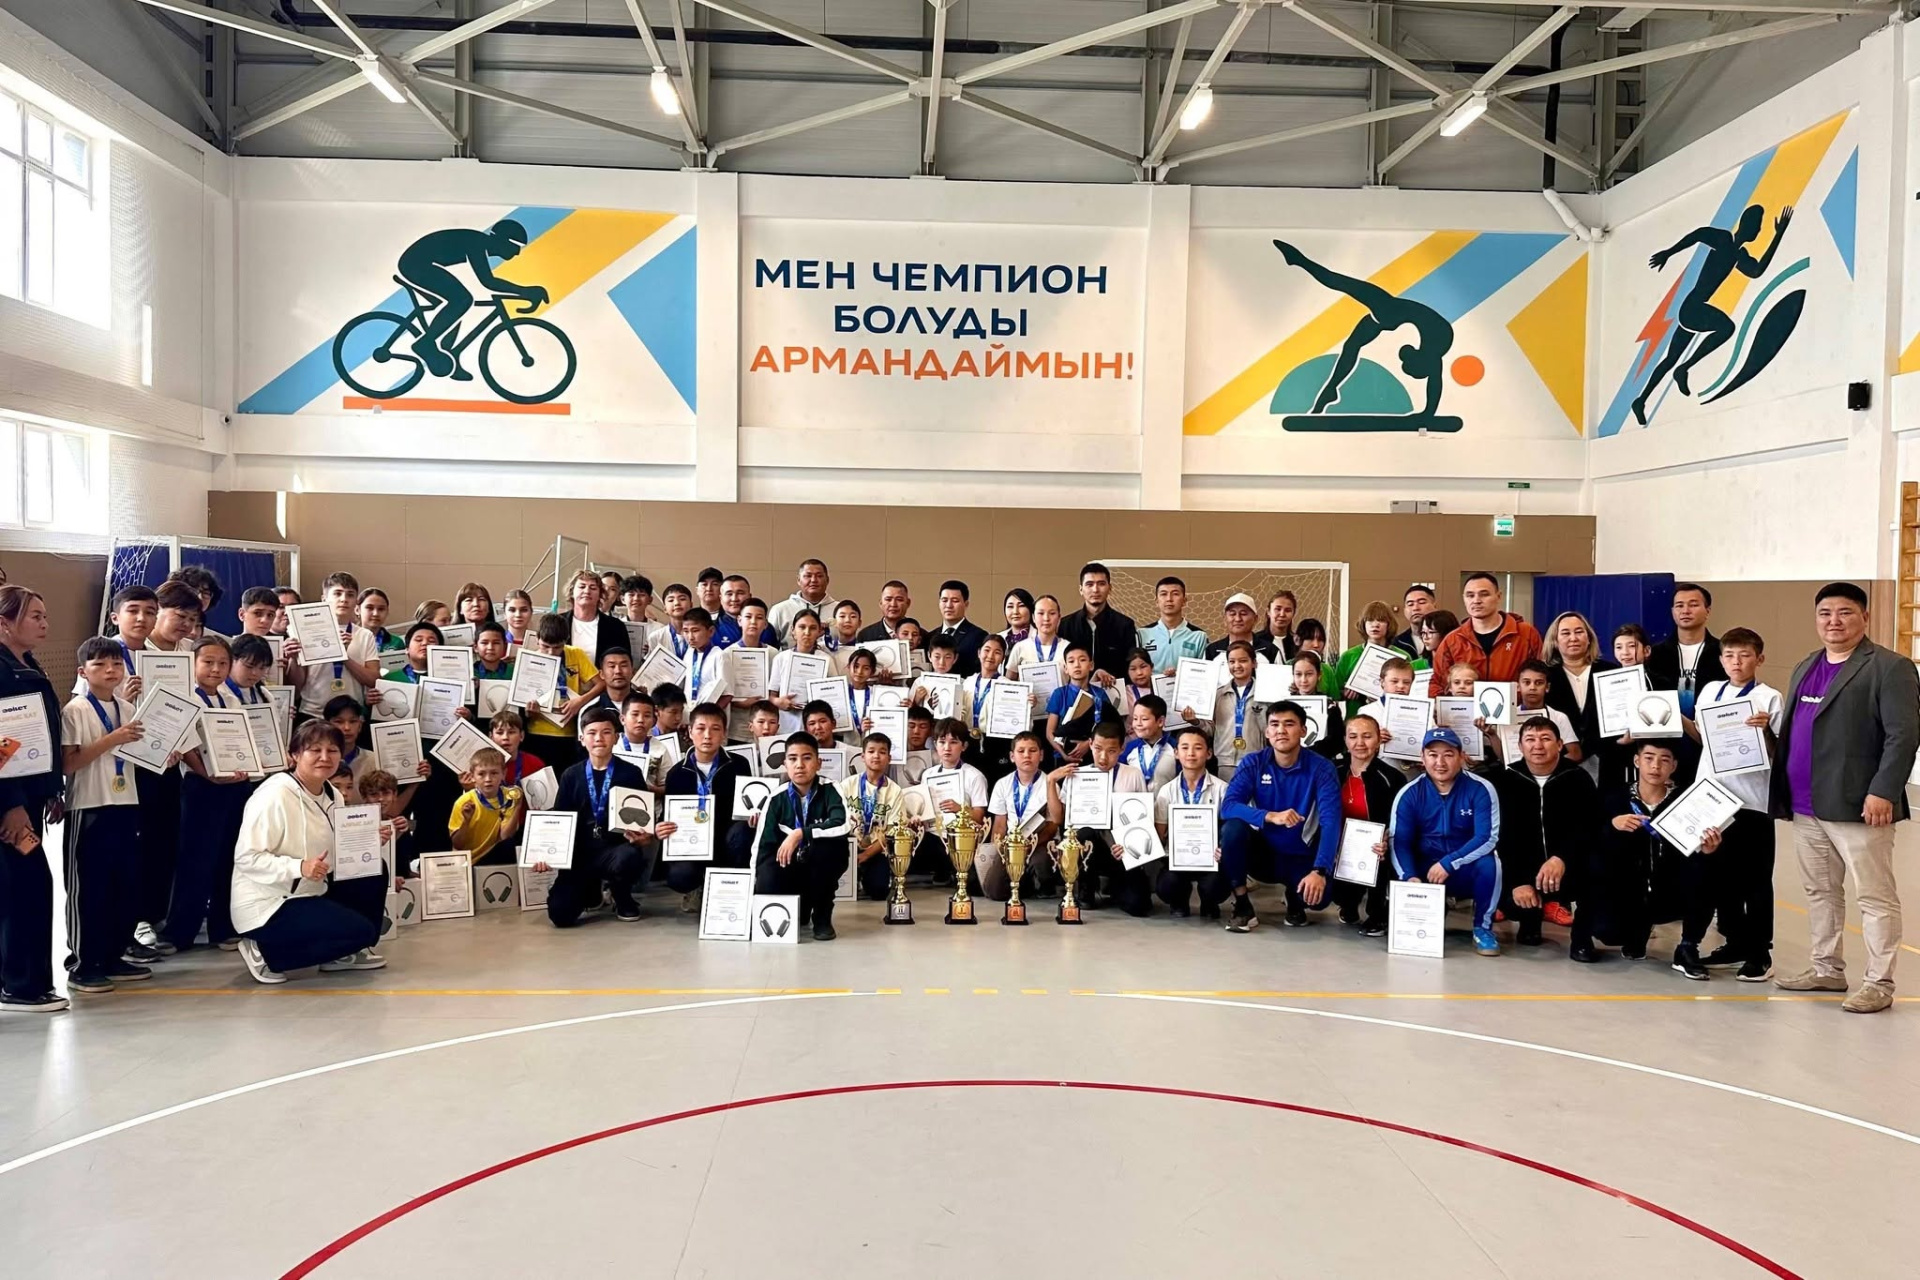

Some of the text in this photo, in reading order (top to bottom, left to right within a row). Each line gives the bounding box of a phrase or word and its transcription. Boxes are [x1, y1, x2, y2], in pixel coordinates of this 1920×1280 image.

[756, 259, 1107, 294] МЕН ЧЕМПИОН
[834, 305, 1027, 339] БОЛУДЫ
[750, 344, 1134, 380] АРМАНДАЙМЫН!
